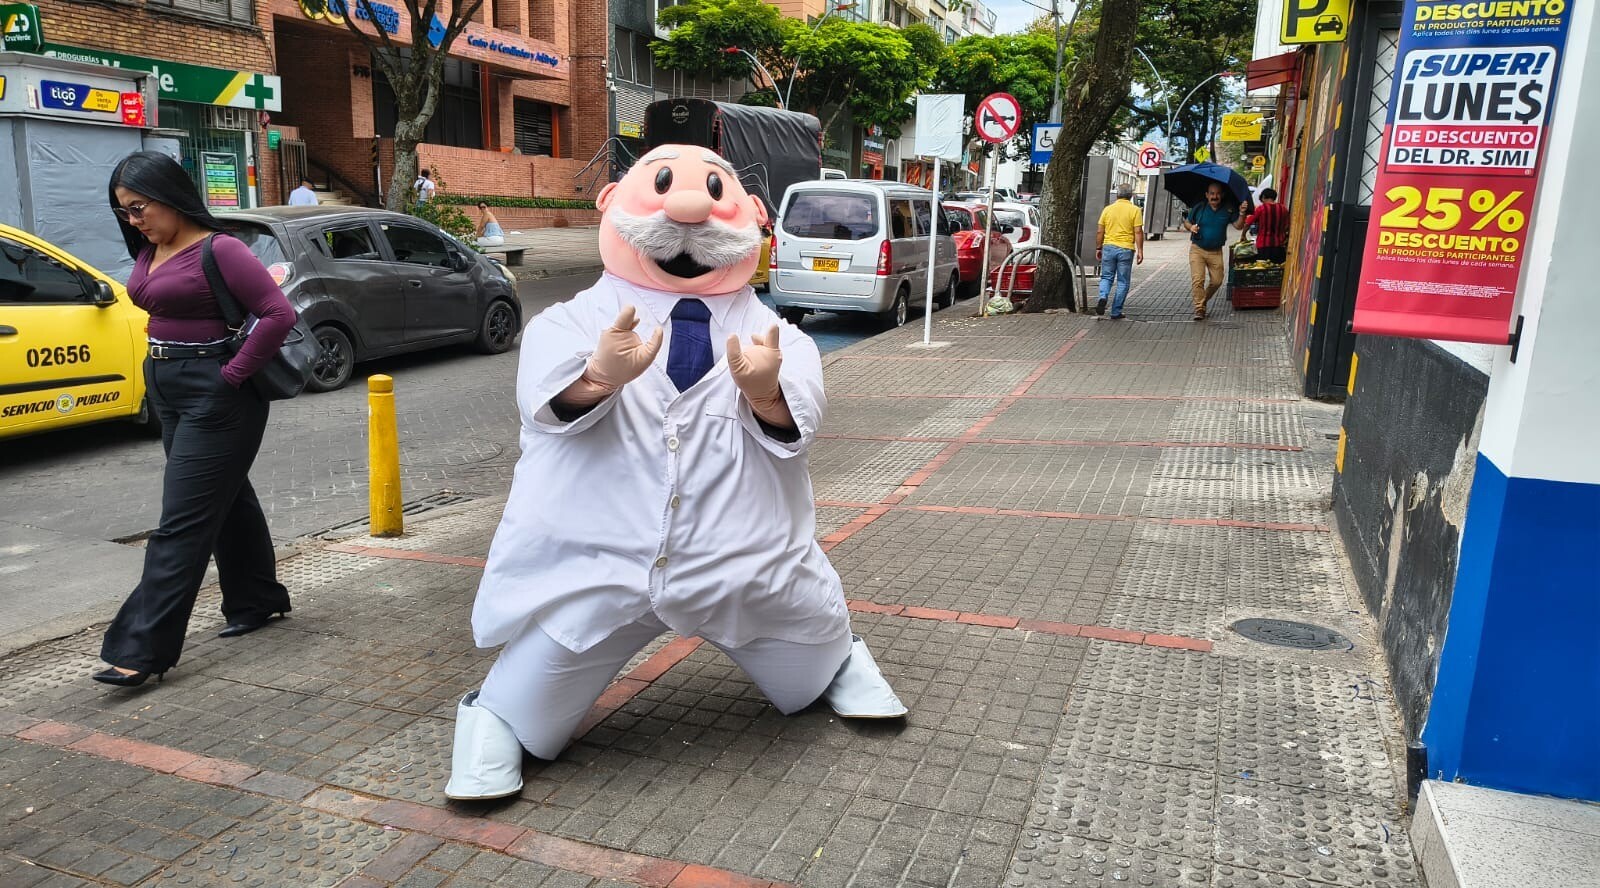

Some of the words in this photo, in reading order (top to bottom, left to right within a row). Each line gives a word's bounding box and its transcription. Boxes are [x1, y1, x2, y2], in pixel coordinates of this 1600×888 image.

[1415, 0, 1565, 21] DESCUENTO
[1412, 30, 1433, 38] Aplica
[1434, 29, 1454, 37] todos
[1413, 23, 1426, 31] EN
[1428, 20, 1484, 30] PRODUCTOS
[1486, 17, 1561, 28] PARTICIPANTES
[57, 52, 100, 64] DROGUERÍAS
[1405, 52, 1550, 80] ¡SUPER!
[1398, 79, 1543, 125] LUNE$
[1398, 129, 1421, 143] DE
[1424, 131, 1534, 145] DESCUENTO
[1394, 148, 1435, 164] DEL
[1439, 149, 1475, 166] DR.
[1481, 150, 1529, 167] SIMI
[1379, 185, 1525, 233] 25%
[1378, 231, 1519, 254] DESCUENTO
[1377, 247, 1389, 255] EN
[1391, 248, 1445, 258] PRODUCTOS
[1446, 251, 1516, 262] PARTICIPANTES
[26, 344, 91, 368] 02656
[1, 399, 55, 418] SERVICIO
[75, 391, 120, 407] PUBLICO
